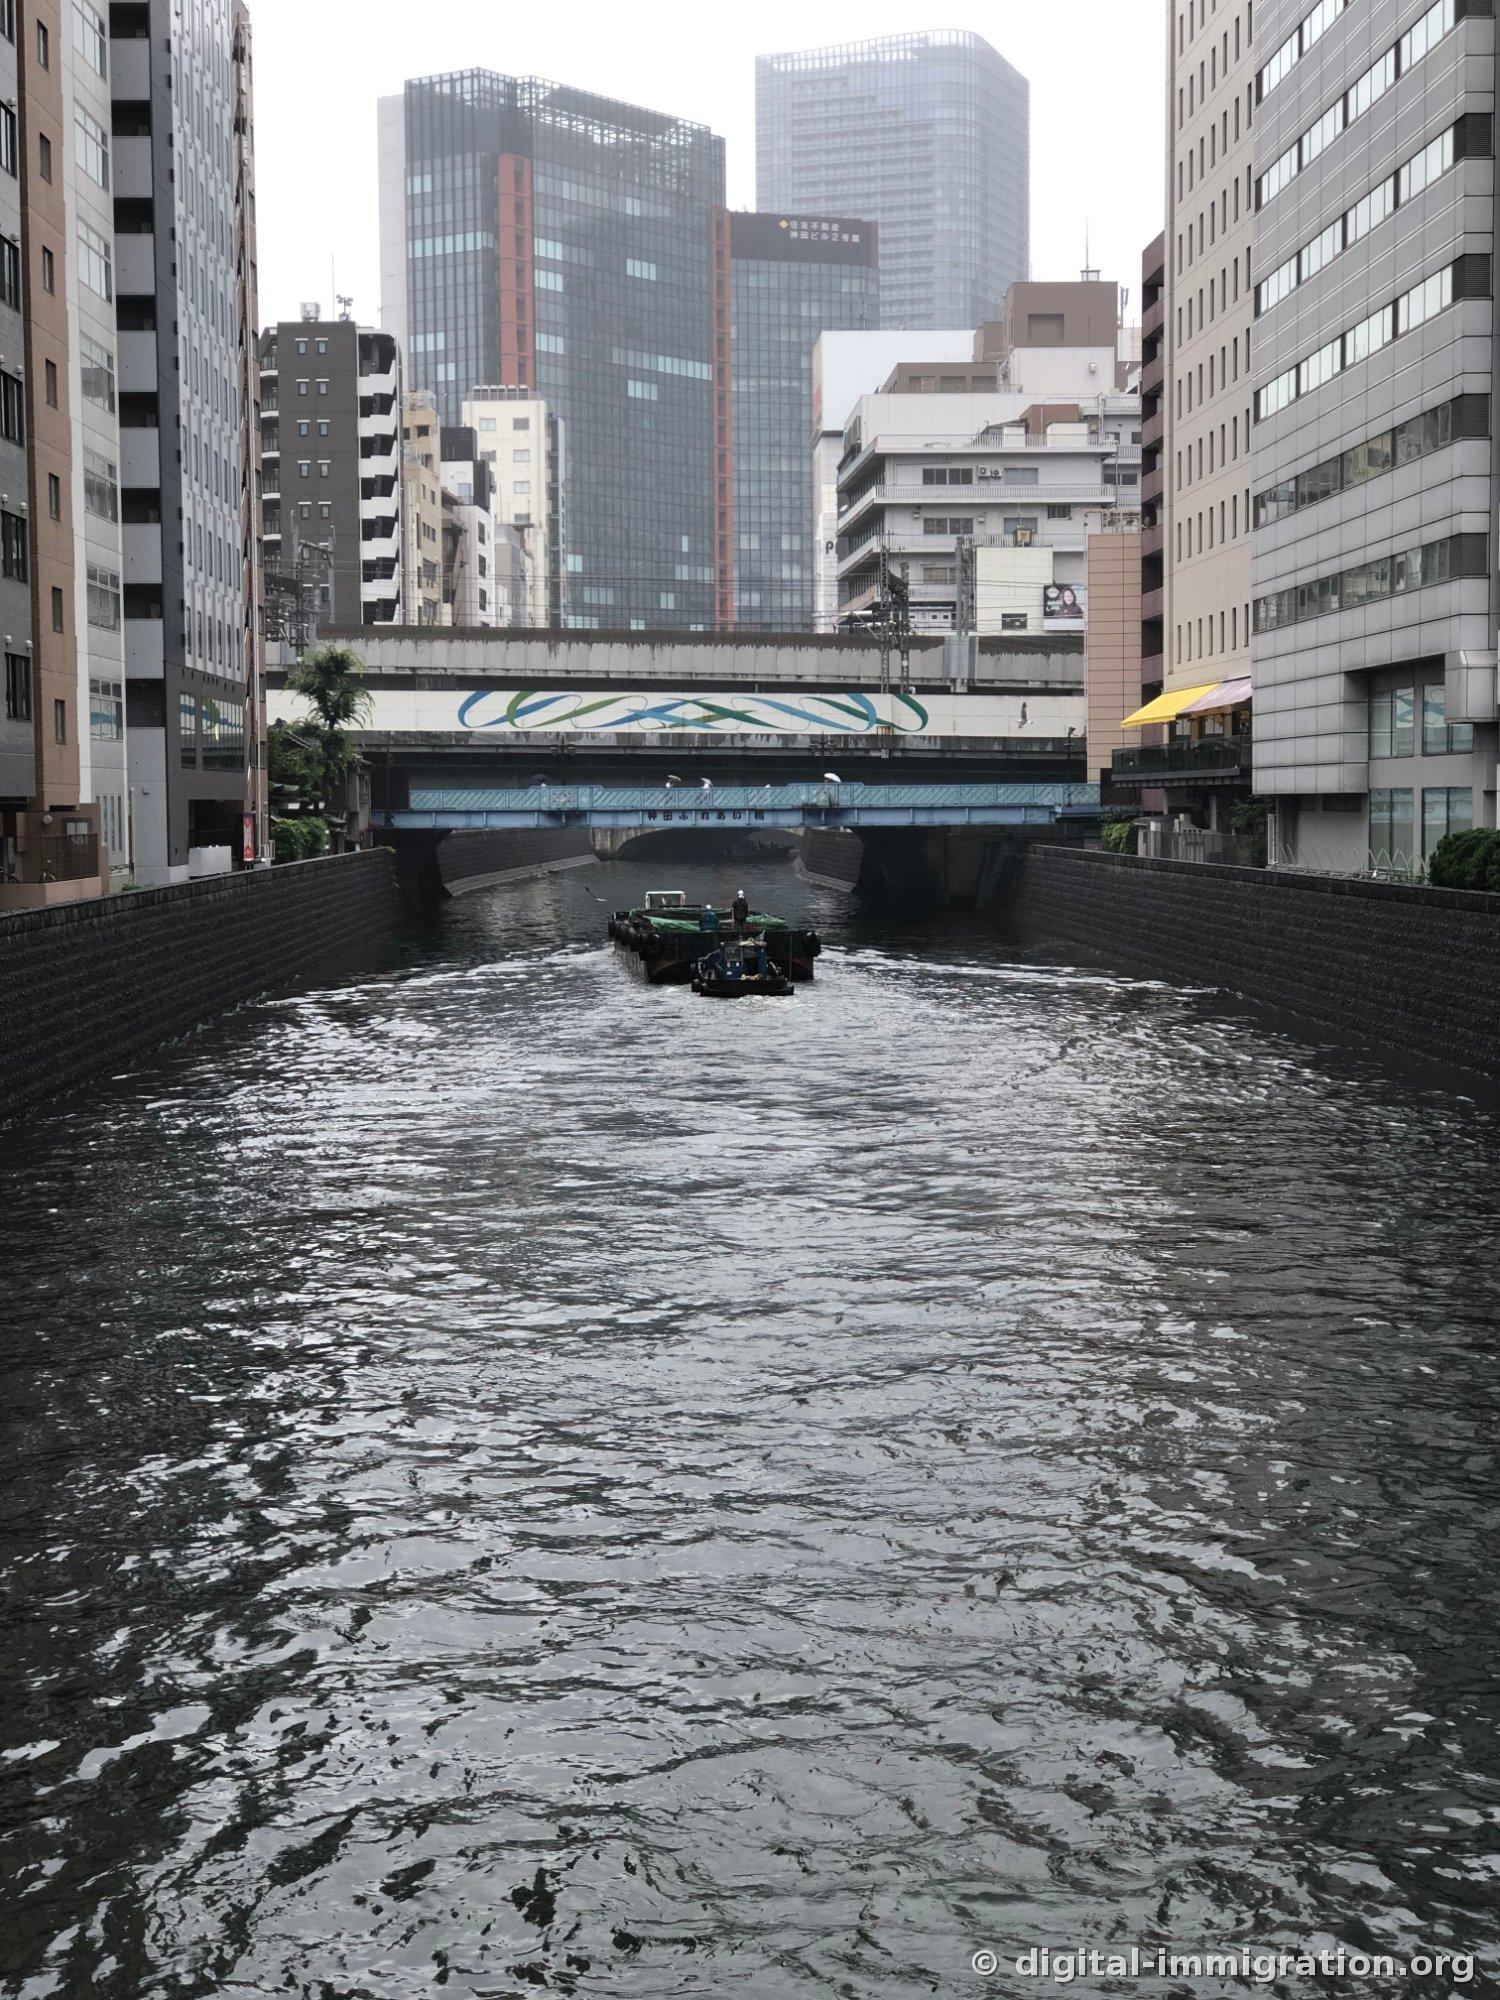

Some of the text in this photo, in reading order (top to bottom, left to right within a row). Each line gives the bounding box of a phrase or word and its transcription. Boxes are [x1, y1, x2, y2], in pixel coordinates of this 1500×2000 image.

[647, 809, 765, 821] 神田ふれあい橋
